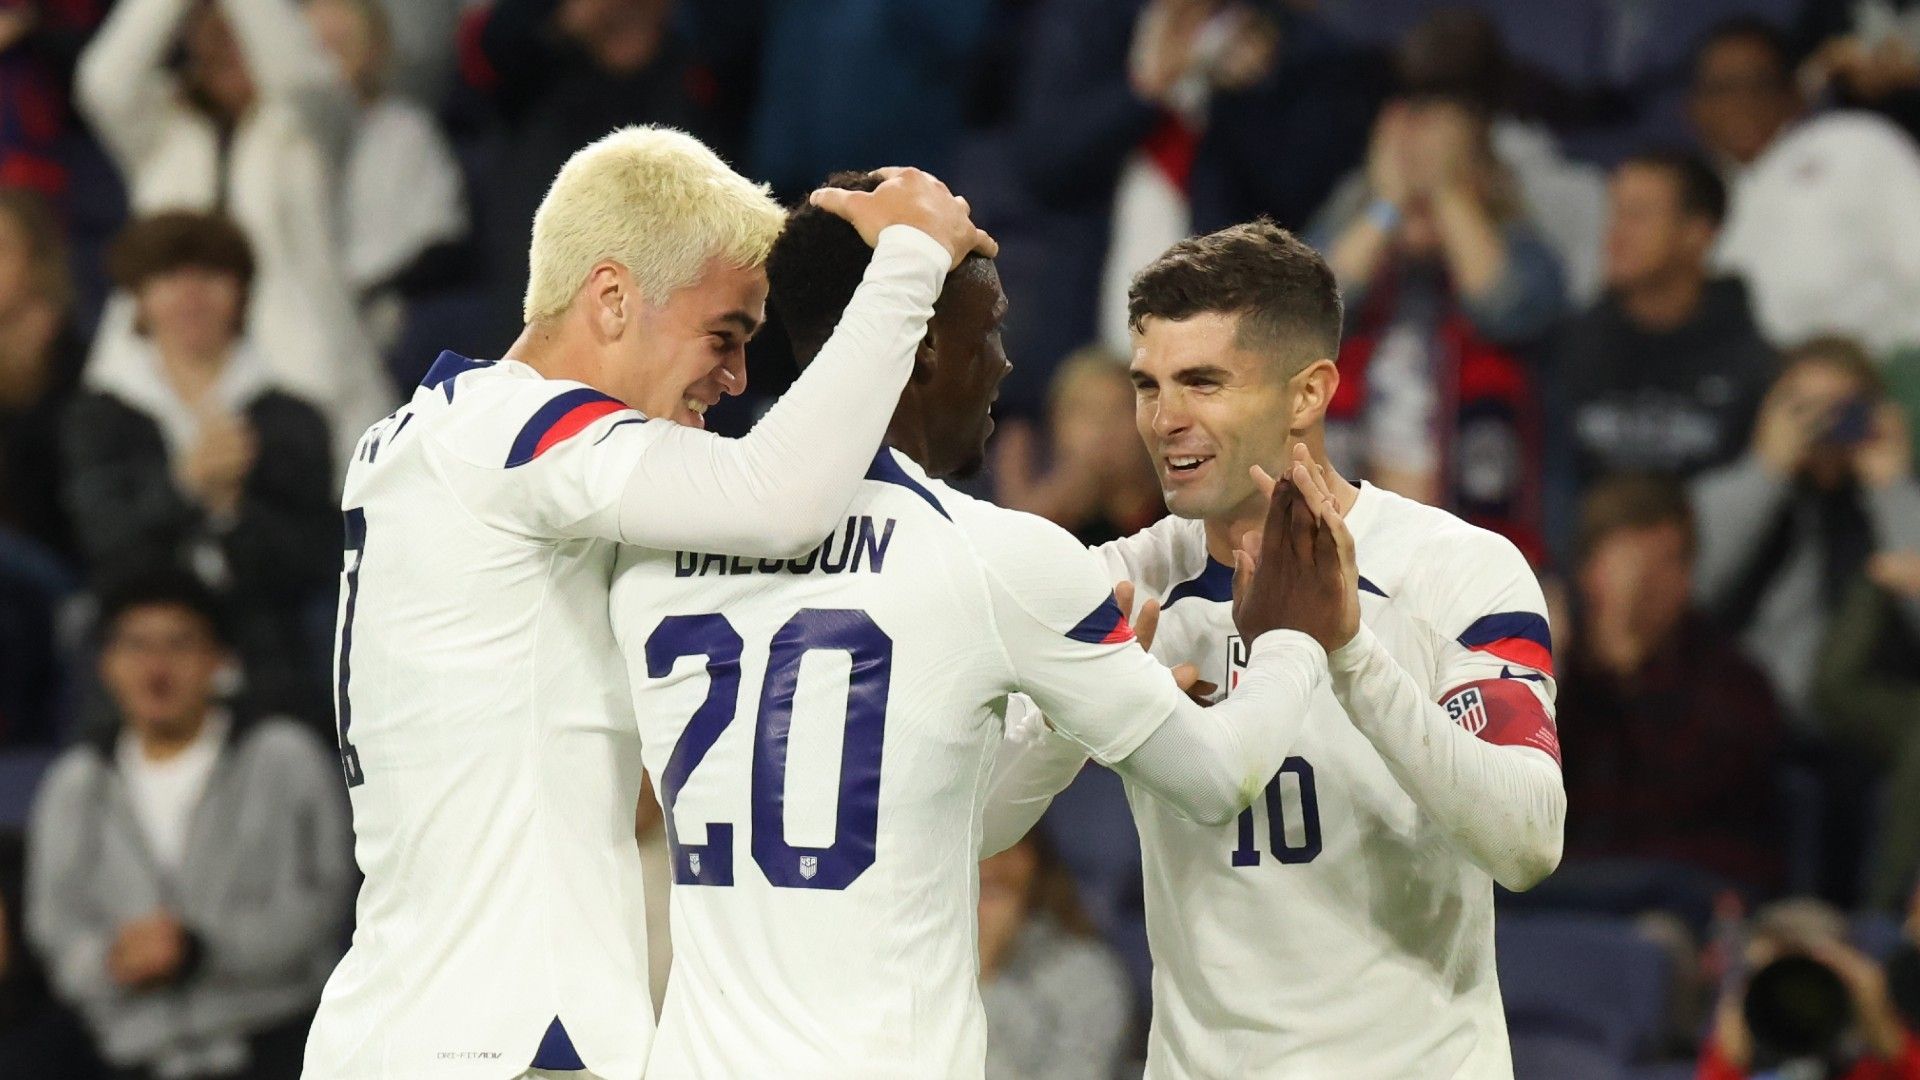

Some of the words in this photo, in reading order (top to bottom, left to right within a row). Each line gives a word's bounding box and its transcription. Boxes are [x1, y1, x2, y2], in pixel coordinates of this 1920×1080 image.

[645, 608, 893, 890] 20
[1446, 690, 1479, 720] SA
[1231, 755, 1323, 867] 10
